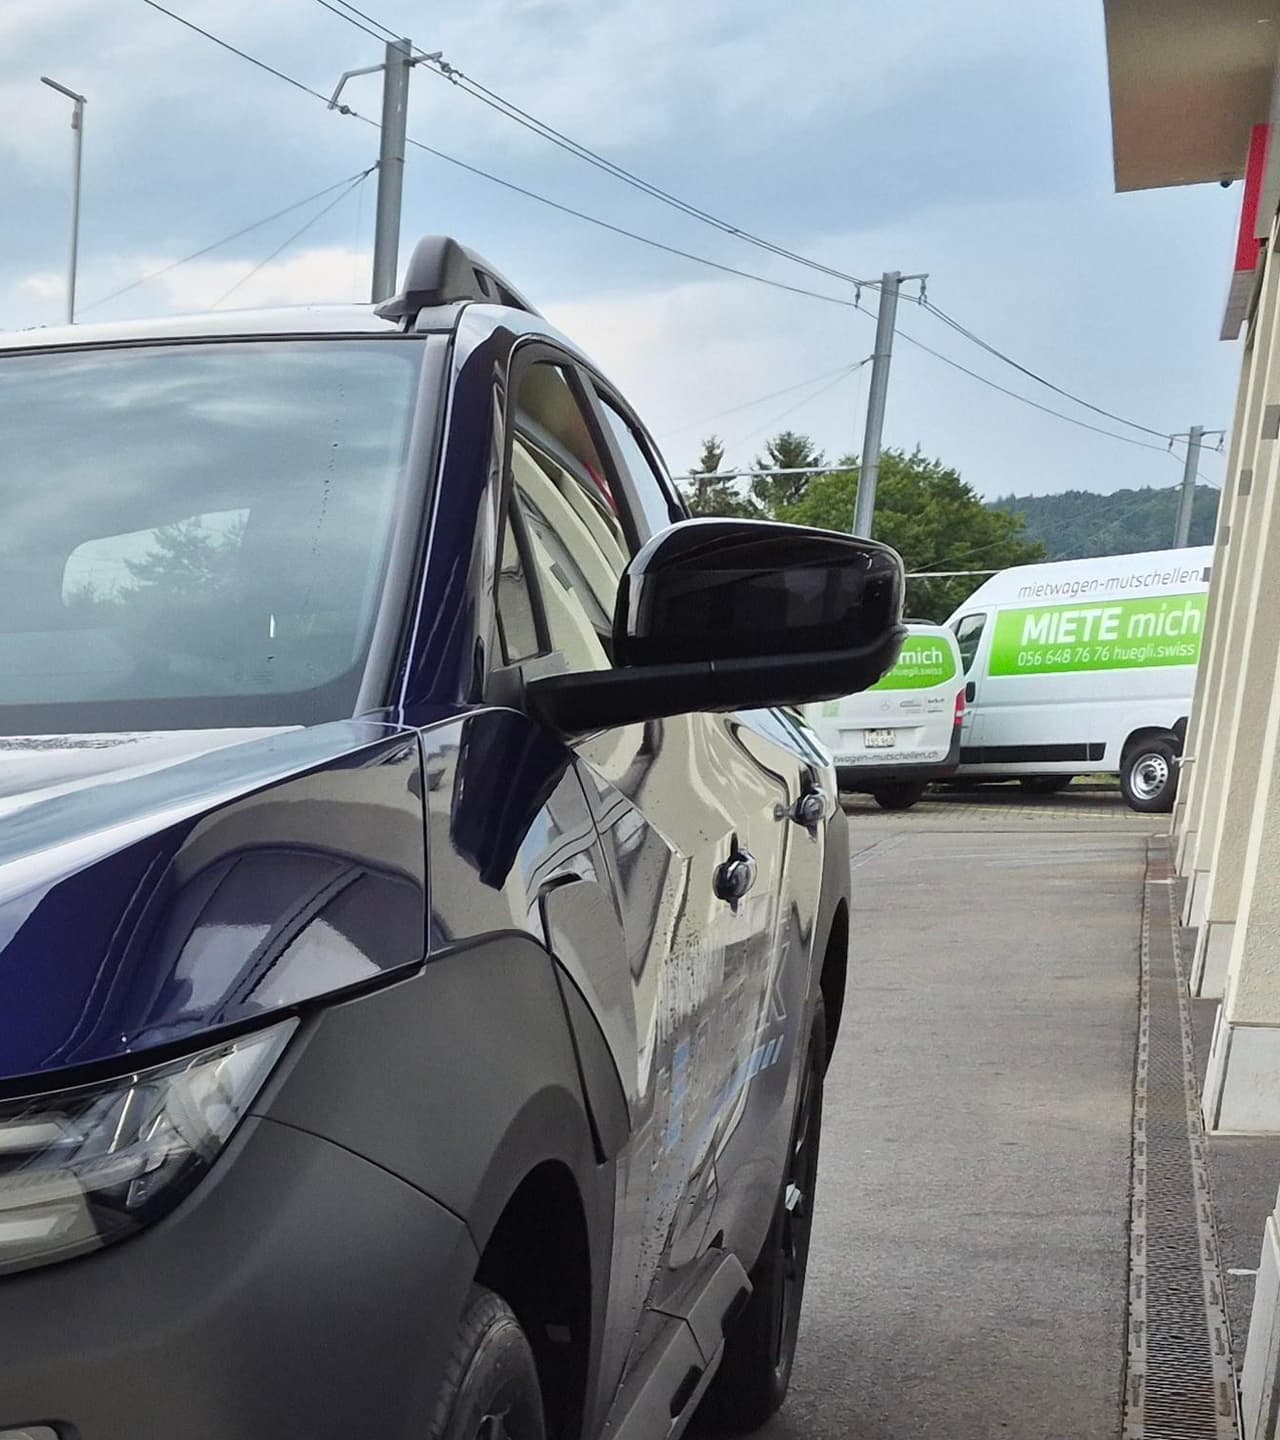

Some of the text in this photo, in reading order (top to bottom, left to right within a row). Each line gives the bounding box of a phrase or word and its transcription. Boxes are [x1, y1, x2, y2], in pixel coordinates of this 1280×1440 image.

[1020, 600, 1202, 647] MIETE mich
[899, 646, 943, 665] mich
[1017, 641, 1195, 666] 056 648 76 76 huegli.swiss
